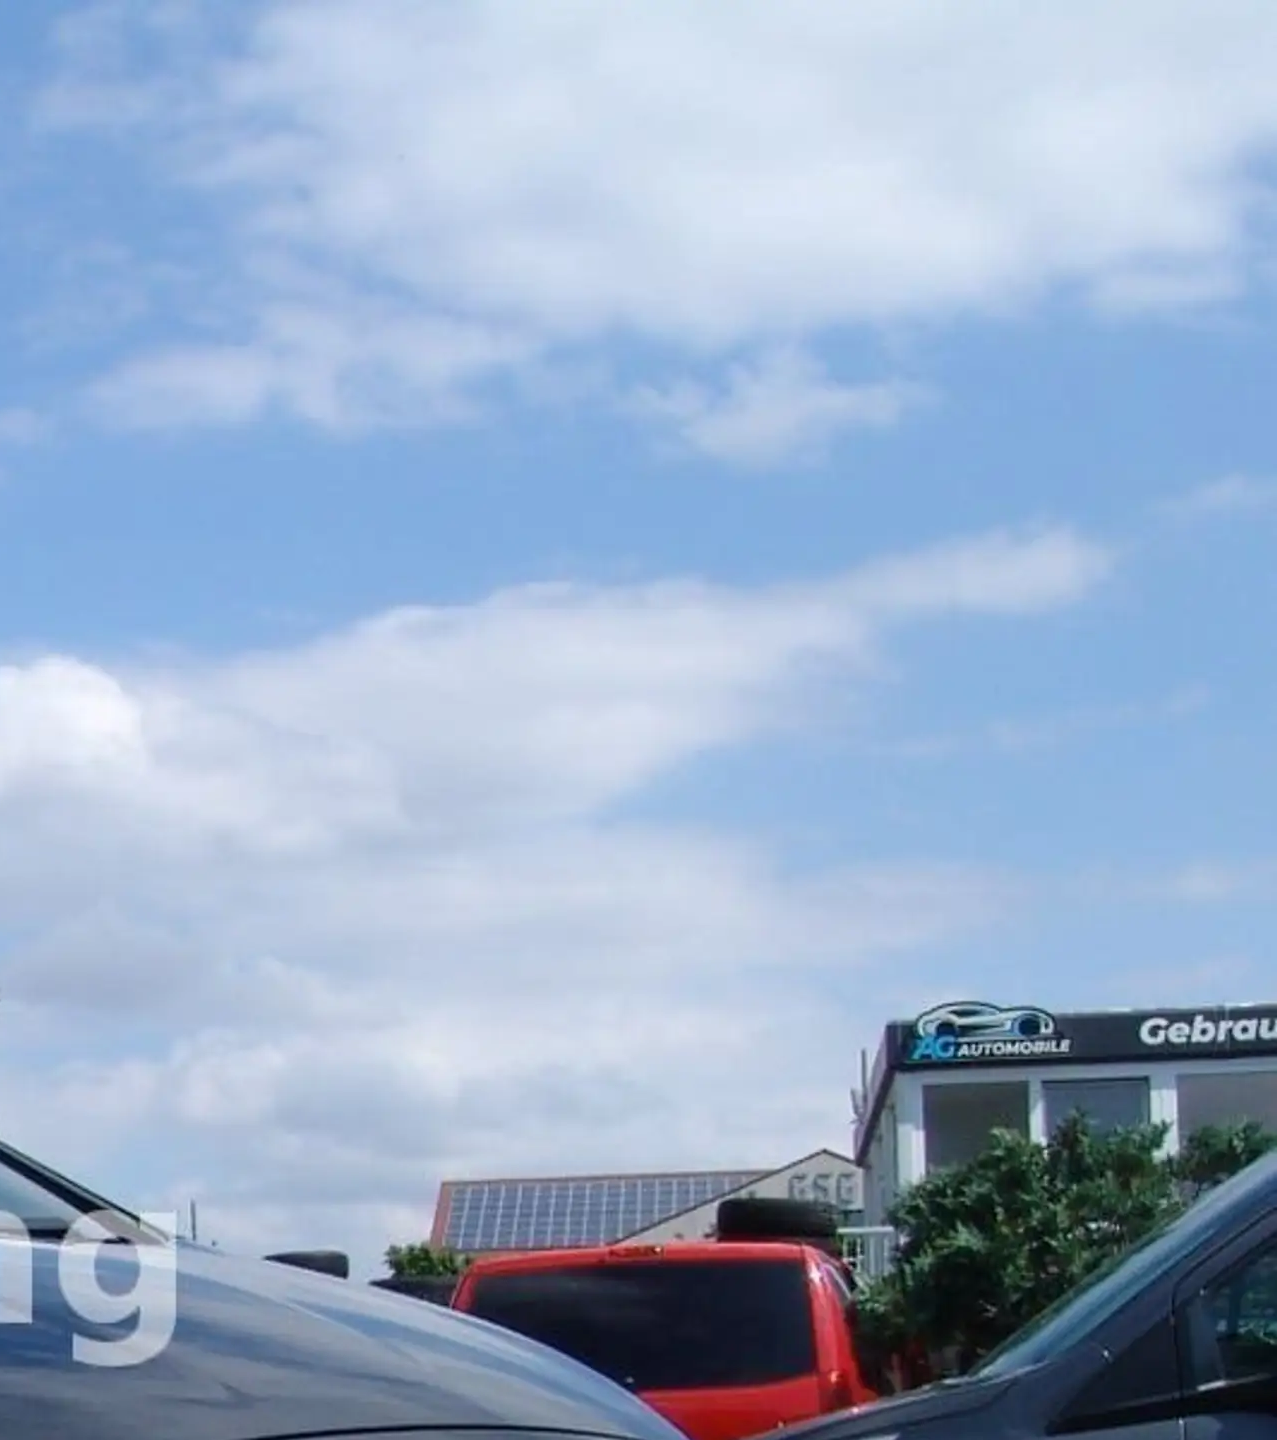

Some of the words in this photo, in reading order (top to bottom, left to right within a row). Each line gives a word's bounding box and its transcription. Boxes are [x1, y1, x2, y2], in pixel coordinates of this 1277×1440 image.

[1140, 1014, 1277, 1045] Gebrau
[911, 1035, 955, 1060] AG
[957, 1038, 1072, 1057] AUTOMOBILE
